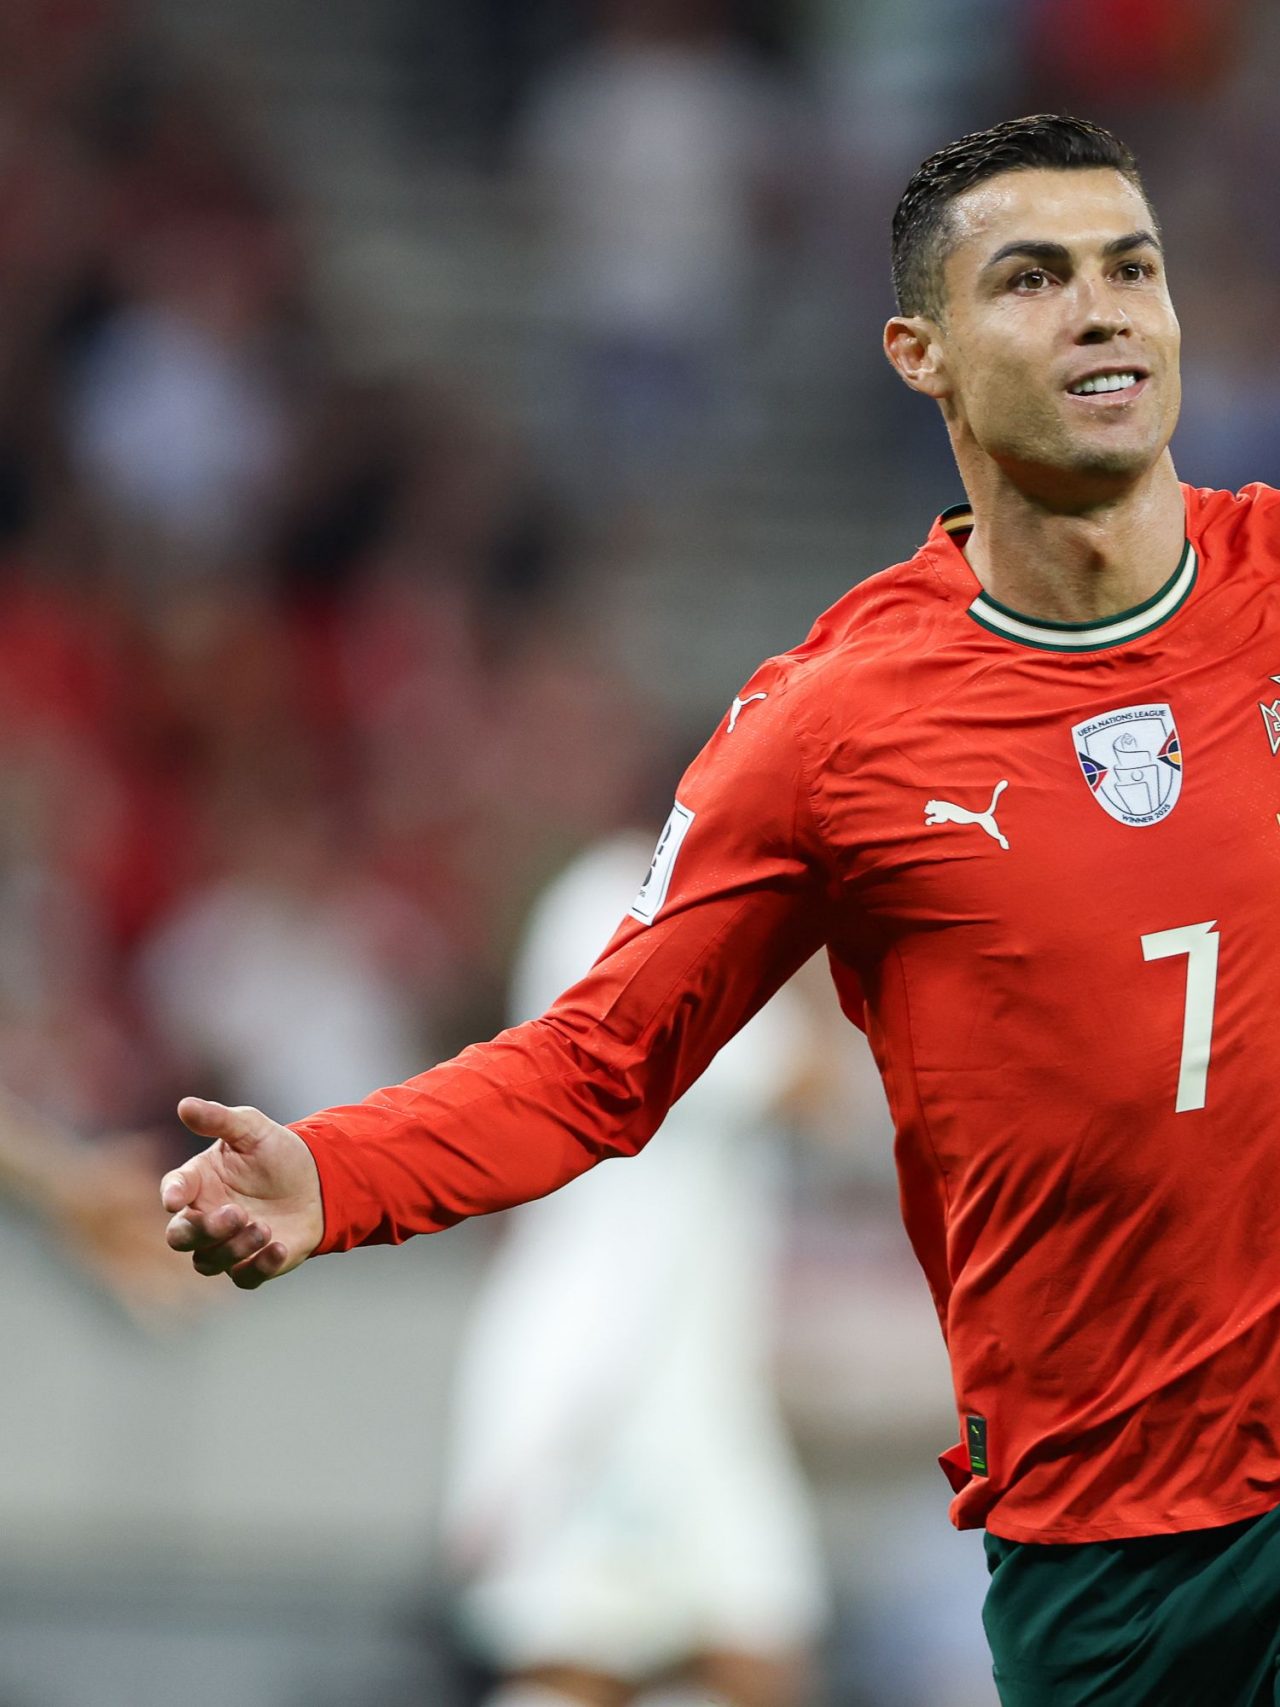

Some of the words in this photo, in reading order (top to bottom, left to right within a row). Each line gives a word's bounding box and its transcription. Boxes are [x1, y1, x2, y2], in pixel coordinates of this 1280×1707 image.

[1077, 724, 1098, 737] UEFA
[1098, 712, 1133, 727] NATIONS
[1134, 709, 1166, 719] LEAGUE
[1122, 814, 1154, 823] WINNER
[1154, 804, 1171, 819] 2025
[1140, 919, 1220, 1113] 7
